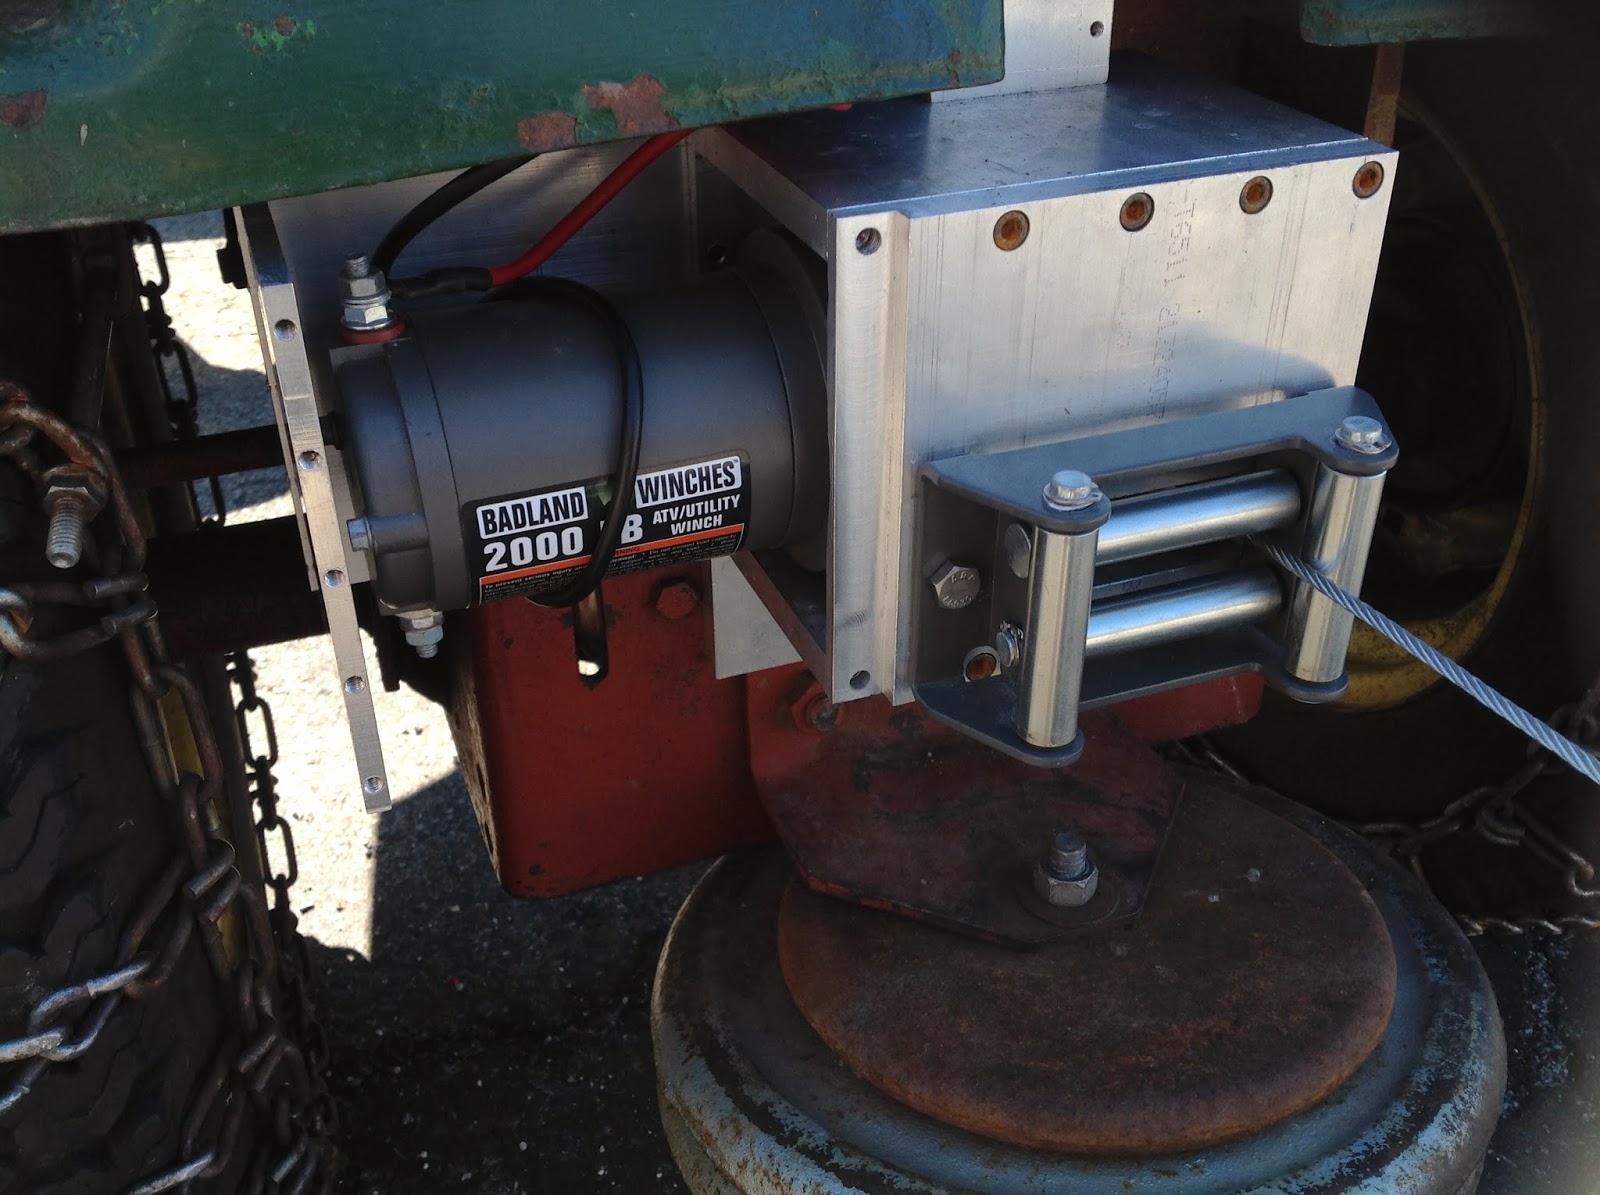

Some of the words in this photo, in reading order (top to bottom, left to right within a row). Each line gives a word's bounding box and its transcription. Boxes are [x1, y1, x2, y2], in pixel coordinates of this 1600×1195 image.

[481, 491, 585, 536] BADLAND
[652, 494, 740, 525] ATV/UTILITY
[670, 514, 722, 536] WINCH
[483, 526, 584, 572] 2000
[495, 579, 522, 589] prevent
[524, 573, 550, 582] serious
